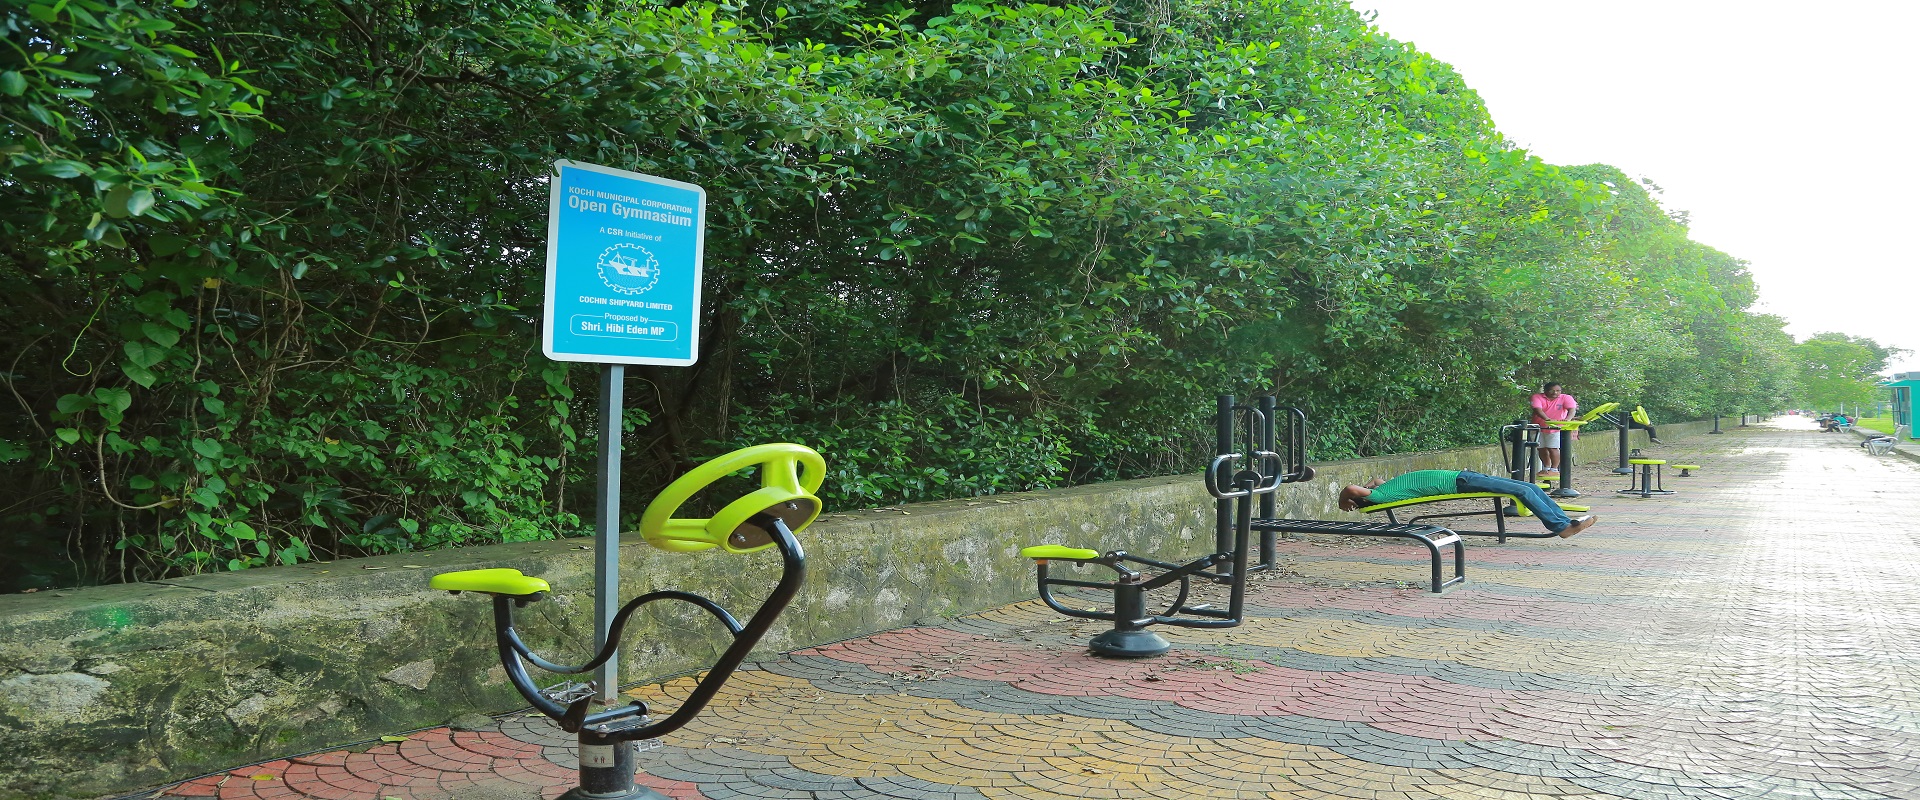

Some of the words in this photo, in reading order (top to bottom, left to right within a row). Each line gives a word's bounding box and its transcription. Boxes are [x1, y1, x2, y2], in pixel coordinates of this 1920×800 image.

[569, 186, 594, 196] KOCHI
[597, 192, 639, 204] MUNICIPAL
[642, 199, 692, 213] CORPORATION
[568, 195, 606, 213] Open
[612, 202, 691, 226] Gymnasium
[608, 228, 623, 236] CSR
[625, 230, 652, 240] Initiative
[579, 296, 607, 304] COCHIN
[609, 299, 644, 308] SHIPYARD
[646, 302, 672, 310] LIMITED
[605, 313, 638, 322] Proposed
[640, 316, 648, 324] by
[581, 322, 602, 331] Shri.
[606, 324, 624, 332] Hibi
[627, 325, 648, 334] Eden
[651, 327, 664, 335] MP
